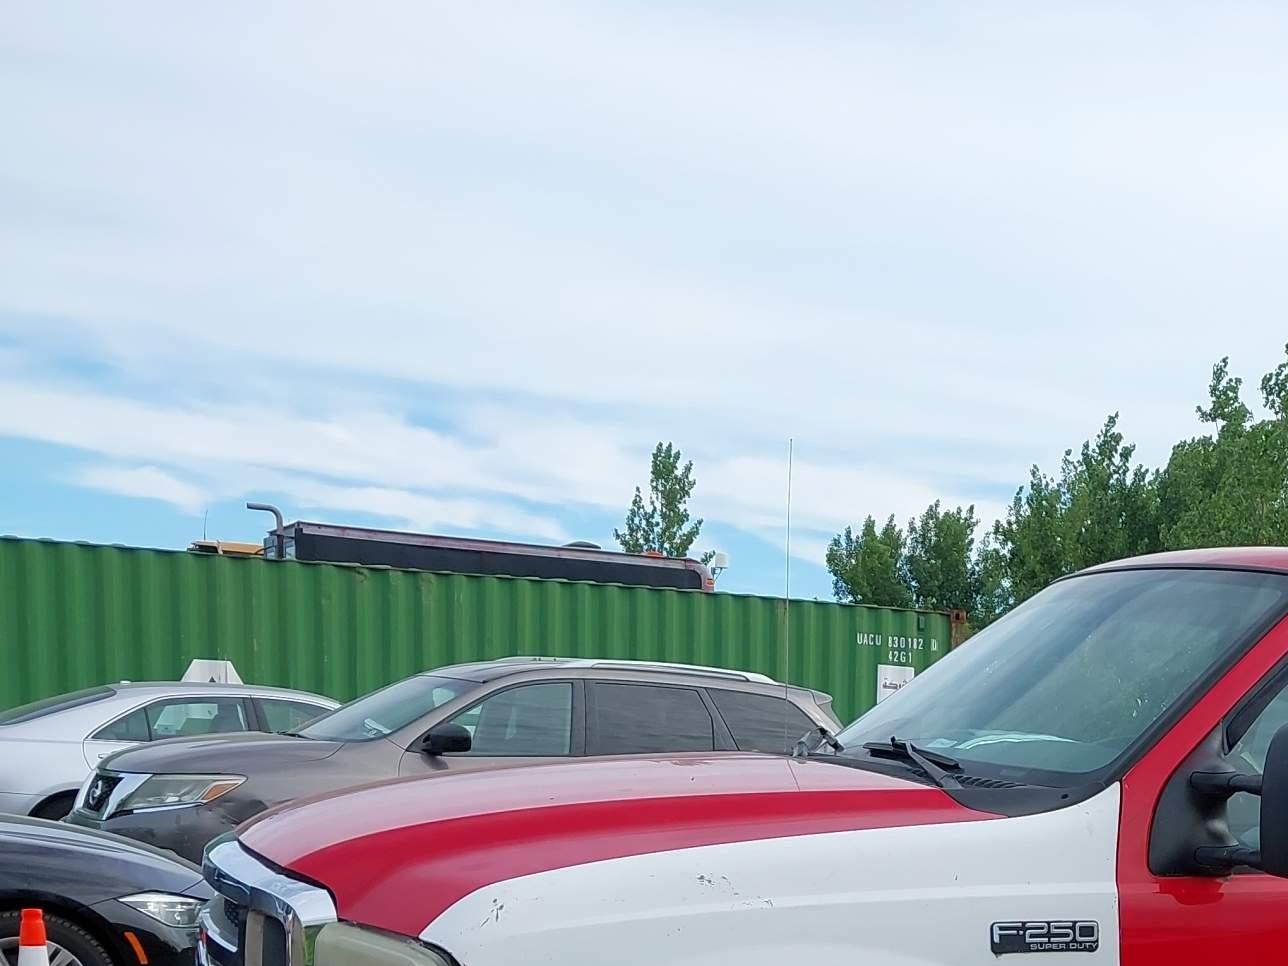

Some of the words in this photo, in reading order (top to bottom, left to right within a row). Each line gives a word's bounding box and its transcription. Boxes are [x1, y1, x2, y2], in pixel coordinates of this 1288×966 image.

[857, 632, 882, 646] UACU
[888, 636, 924, 650] 830182
[888, 651, 912, 664] 42G1
[1030, 942, 1066, 951] SUPER
[1069, 942, 1098, 950] DUTY
